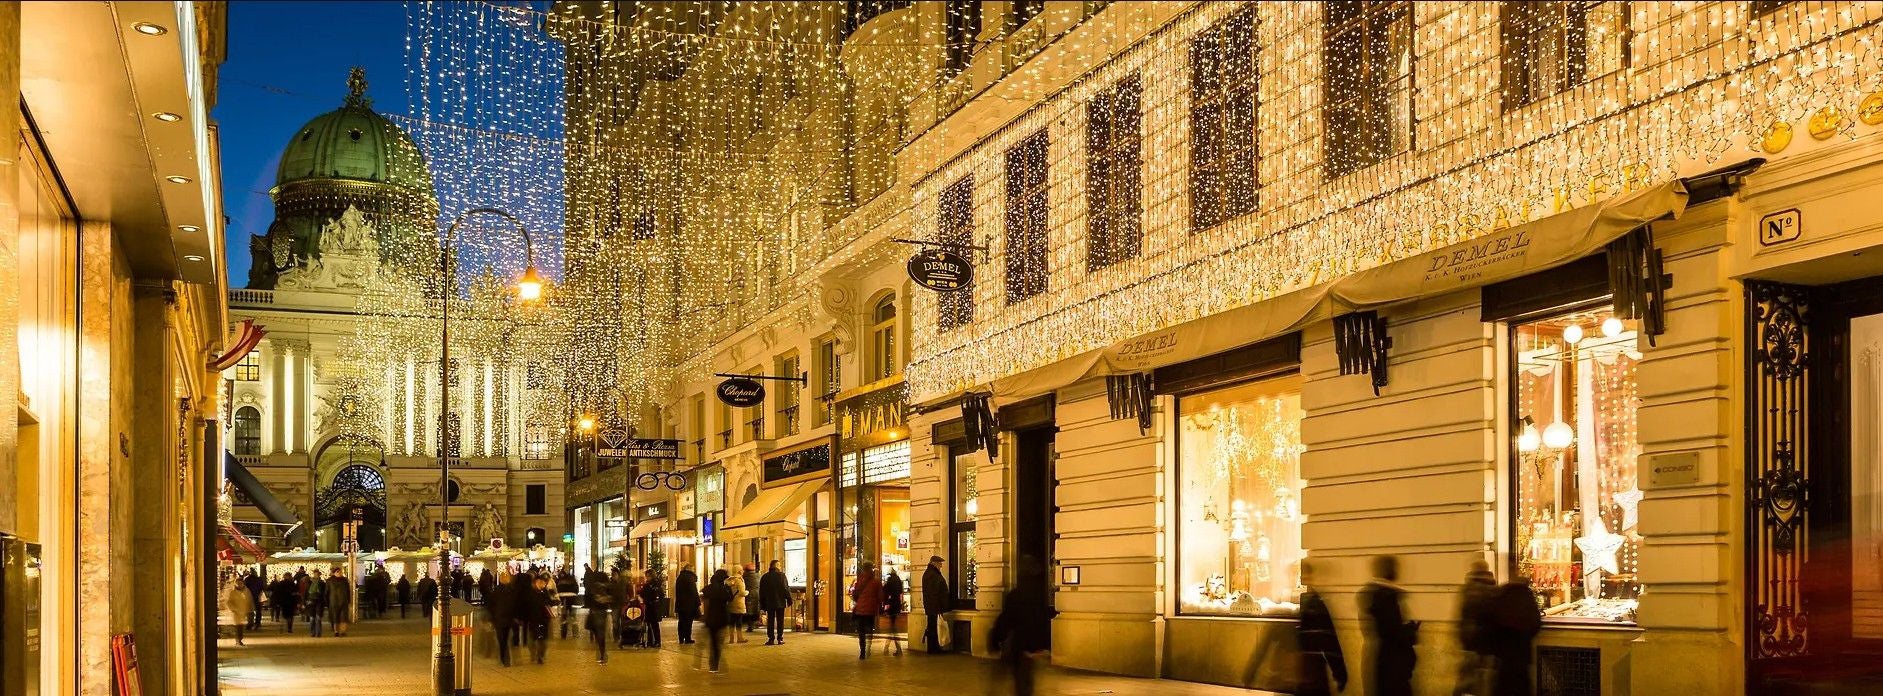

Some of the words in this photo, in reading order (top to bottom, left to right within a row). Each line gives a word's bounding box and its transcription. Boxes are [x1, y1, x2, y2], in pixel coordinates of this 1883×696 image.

[1427, 231, 1531, 272] DEMEL
[923, 261, 961, 275] DEMEL
[1118, 332, 1178, 355] DEMEL
[721, 384, 760, 398] Chopard
[629, 449, 677, 458] ANTIKSCHMUCK
